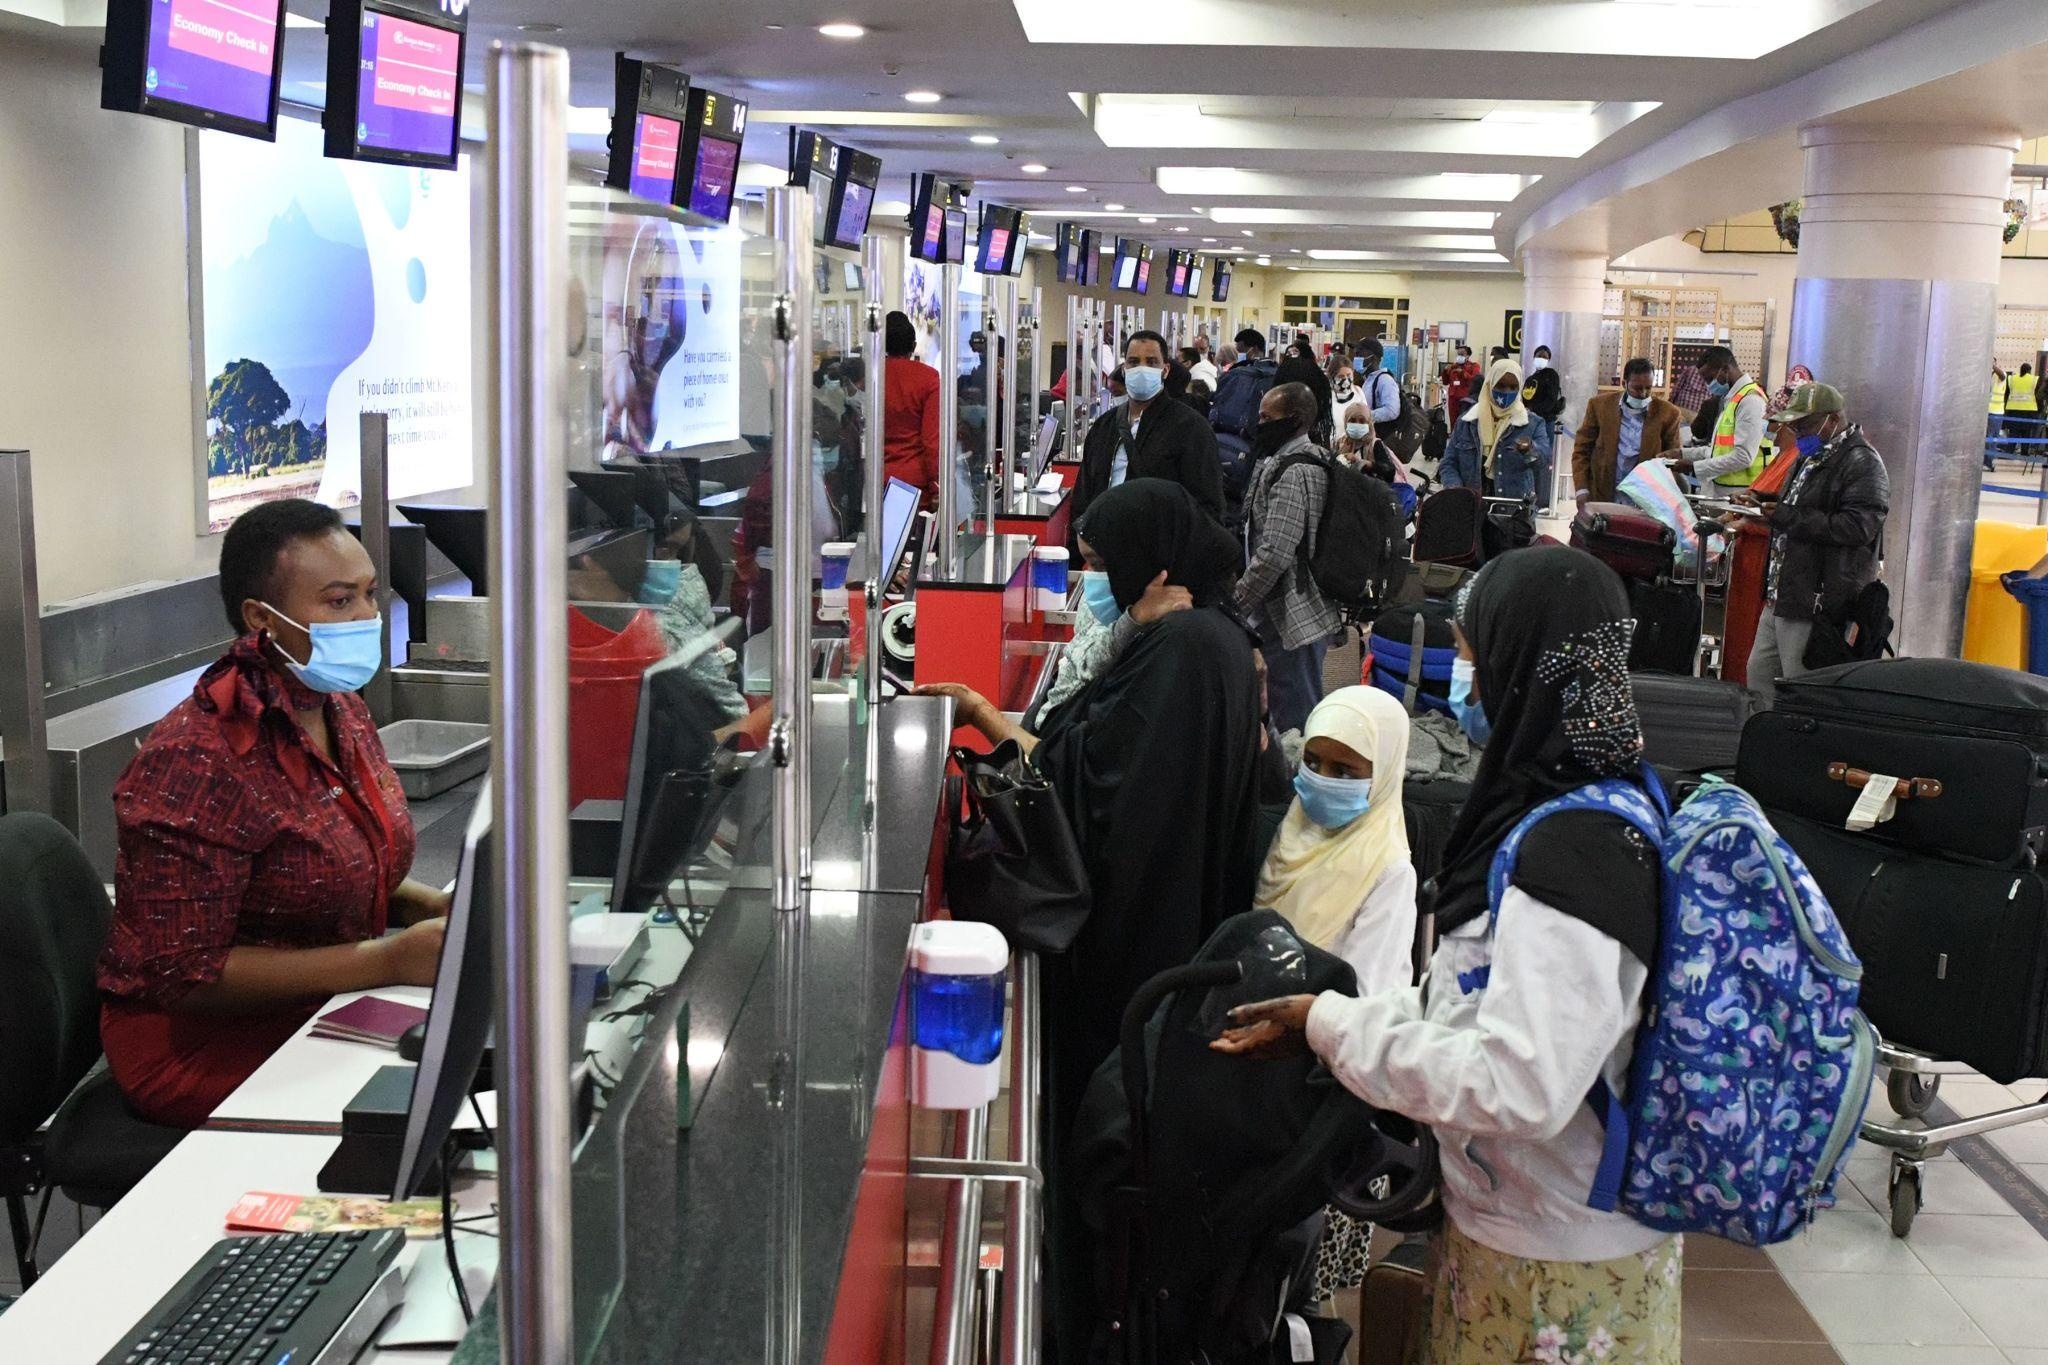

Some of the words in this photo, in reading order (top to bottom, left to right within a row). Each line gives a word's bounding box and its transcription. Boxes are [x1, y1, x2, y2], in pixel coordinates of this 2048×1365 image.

[173, 13, 224, 44] Economy
[225, 30, 257, 52] Check
[377, 77, 416, 96] Economy
[417, 84, 442, 99] Check
[732, 103, 746, 134] 14
[683, 348, 696, 364] Have
[697, 352, 706, 365] you
[359, 379, 365, 397] If
[366, 383, 380, 399] you
[382, 377, 404, 395] didn't
[405, 376, 425, 394] climb
[683, 371, 697, 391] piece
[683, 393, 695, 408] with
